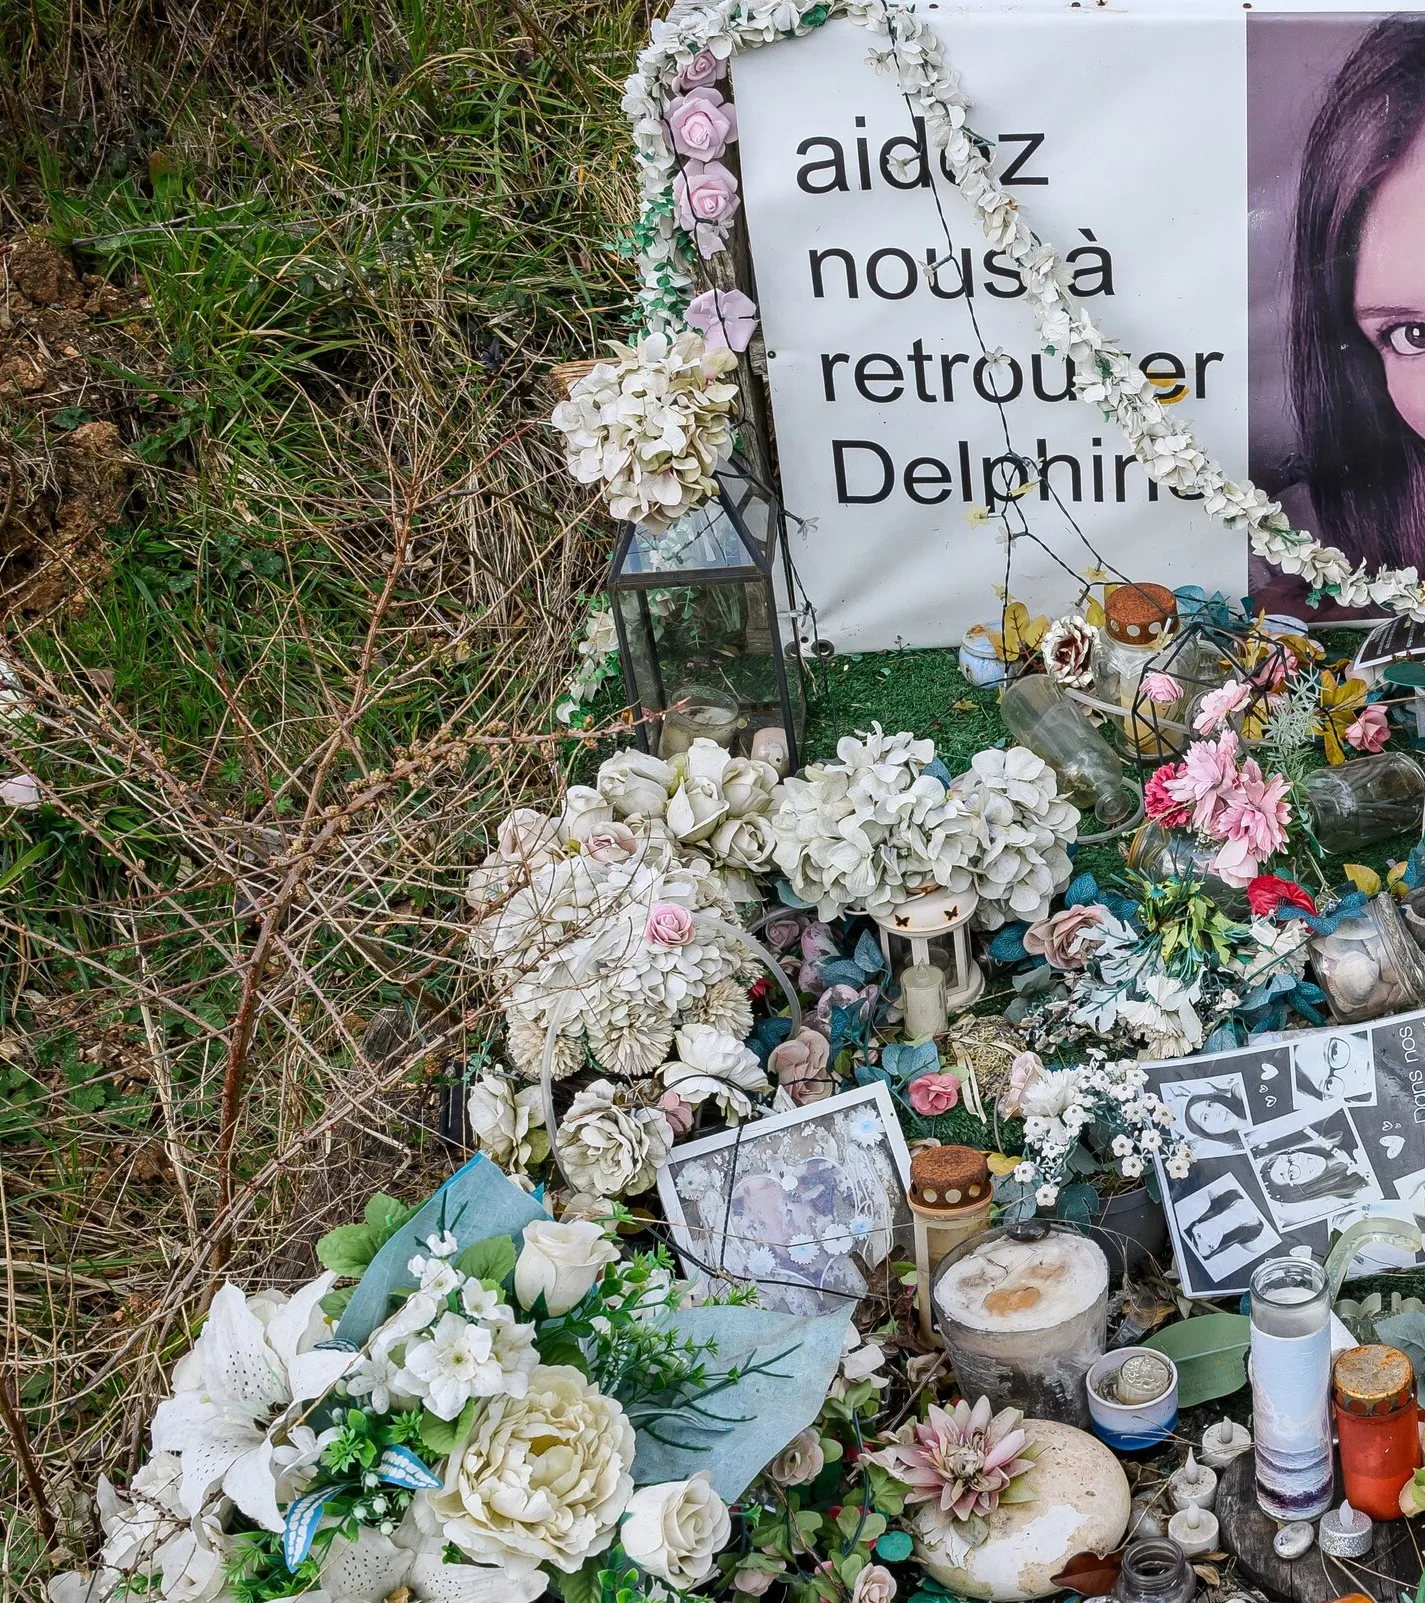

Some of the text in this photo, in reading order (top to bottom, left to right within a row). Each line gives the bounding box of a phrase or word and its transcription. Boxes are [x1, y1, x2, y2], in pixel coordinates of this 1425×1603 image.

[808, 228, 1115, 300] nous à
[820, 338, 1225, 404] retrouer
[1399, 1026, 1419, 1063] nos
